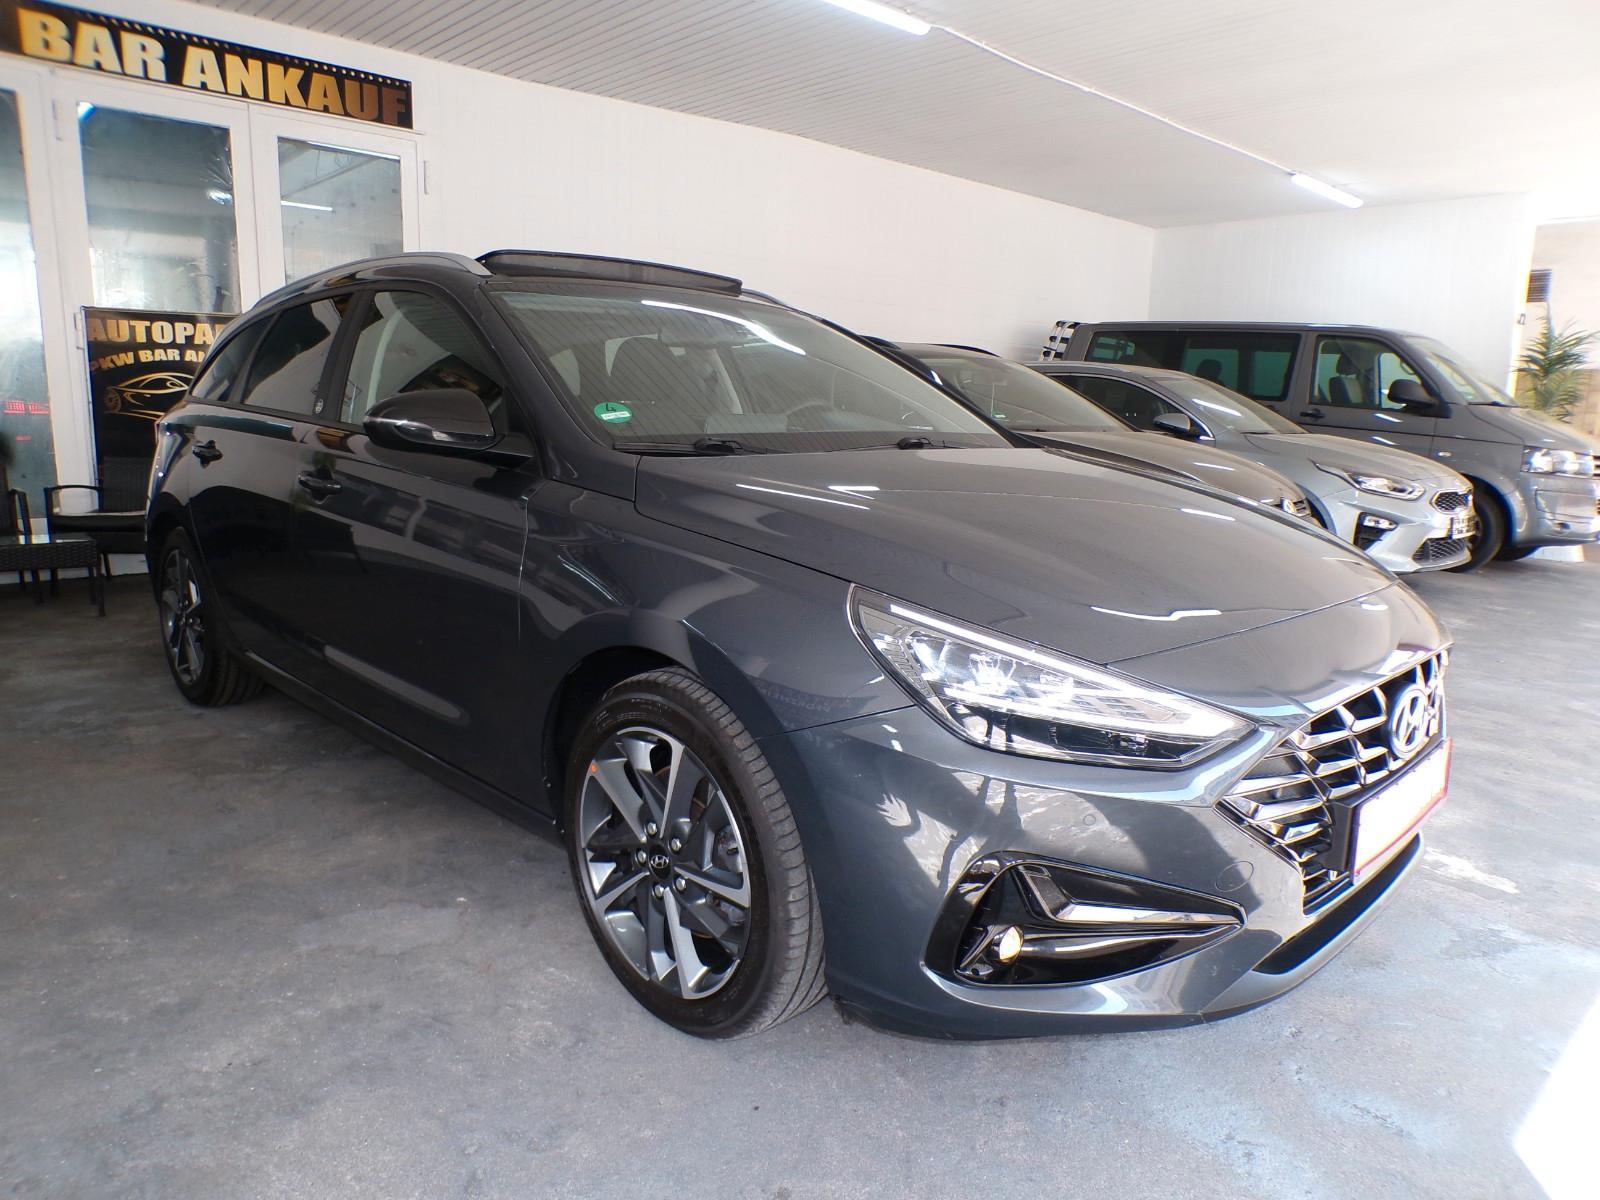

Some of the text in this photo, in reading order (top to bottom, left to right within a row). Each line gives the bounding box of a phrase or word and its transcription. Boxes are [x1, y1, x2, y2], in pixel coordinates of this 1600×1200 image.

[17, 7, 409, 125] BAR ANKAUF
[138, 349, 181, 362] BAR
